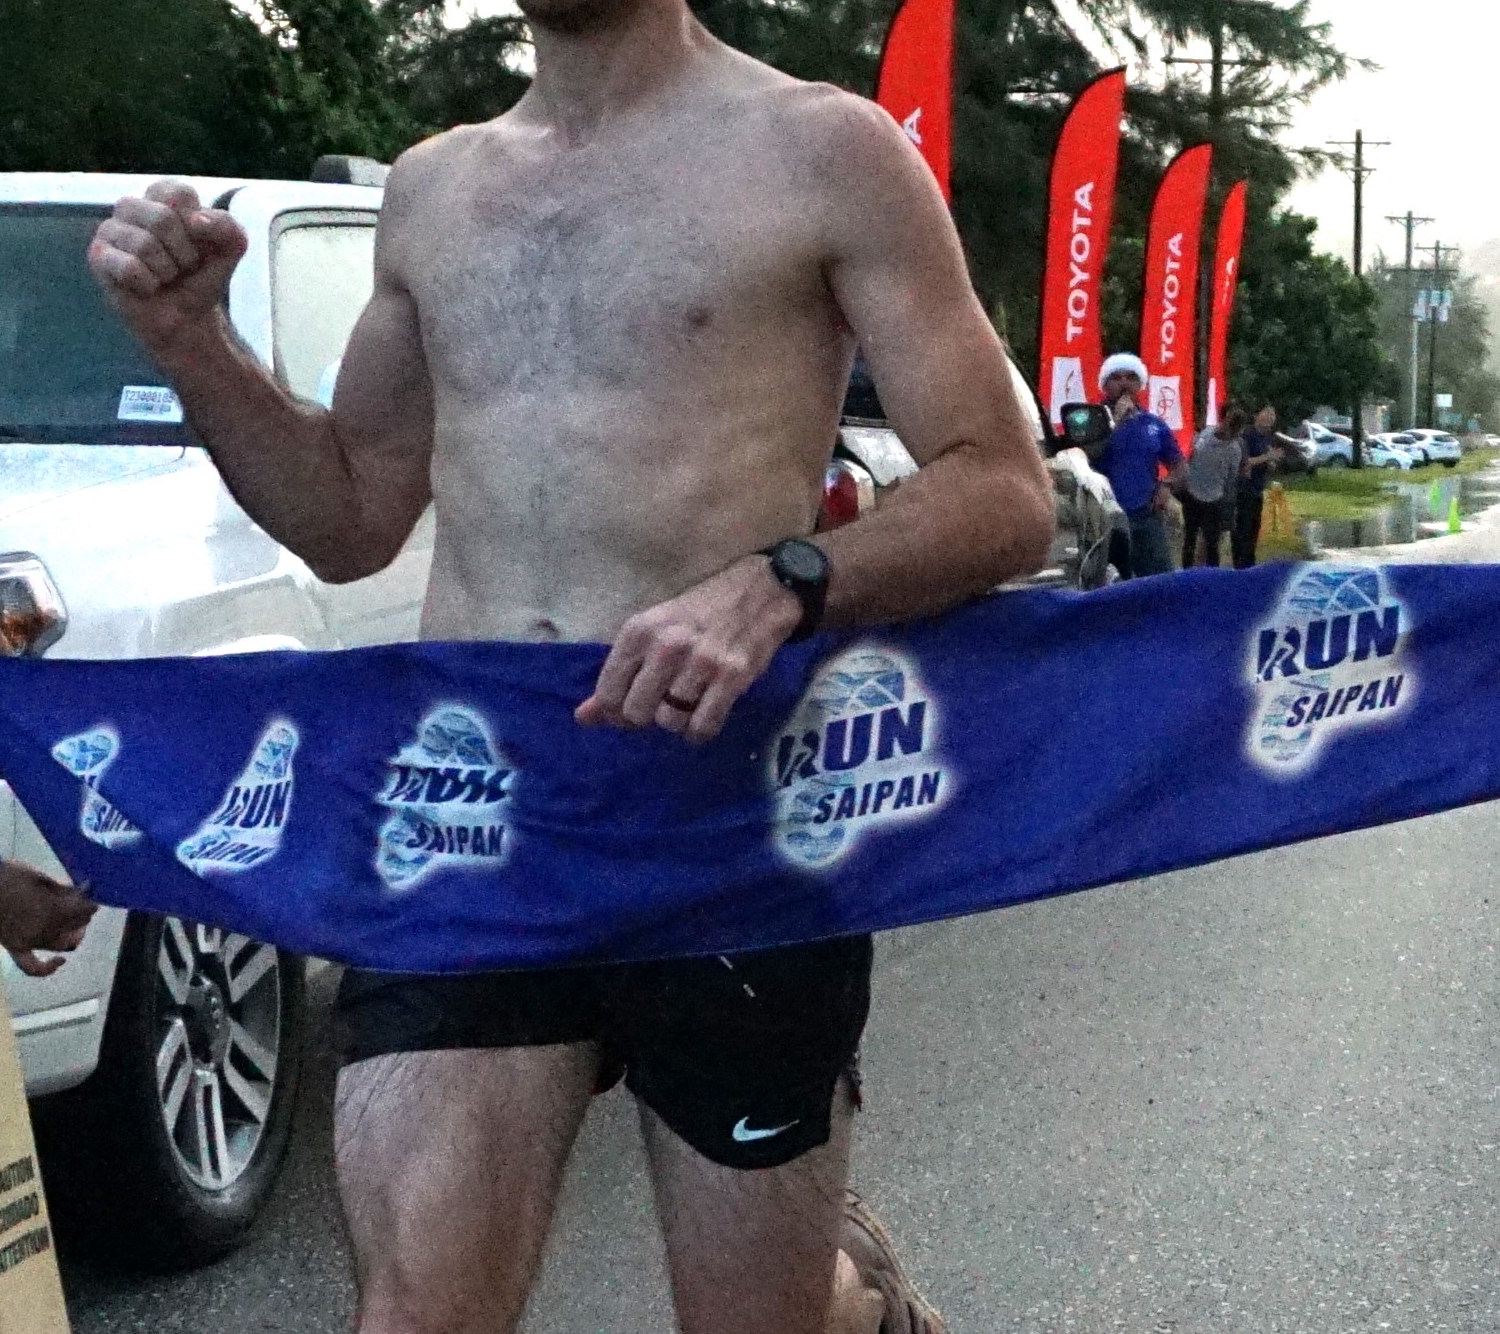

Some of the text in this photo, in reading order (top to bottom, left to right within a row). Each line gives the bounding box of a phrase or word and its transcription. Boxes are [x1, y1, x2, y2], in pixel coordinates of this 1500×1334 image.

[1065, 182, 1094, 343] TOYOTA
[1161, 232, 1183, 363] TOYOTA
[1257, 606, 1399, 682] RUN
[1286, 675, 1403, 727] SAIPAN
[777, 701, 926, 787] RUN
[214, 780, 291, 827] RUN
[813, 771, 940, 824] SAIPAN
[406, 821, 504, 857] SAIPAN
